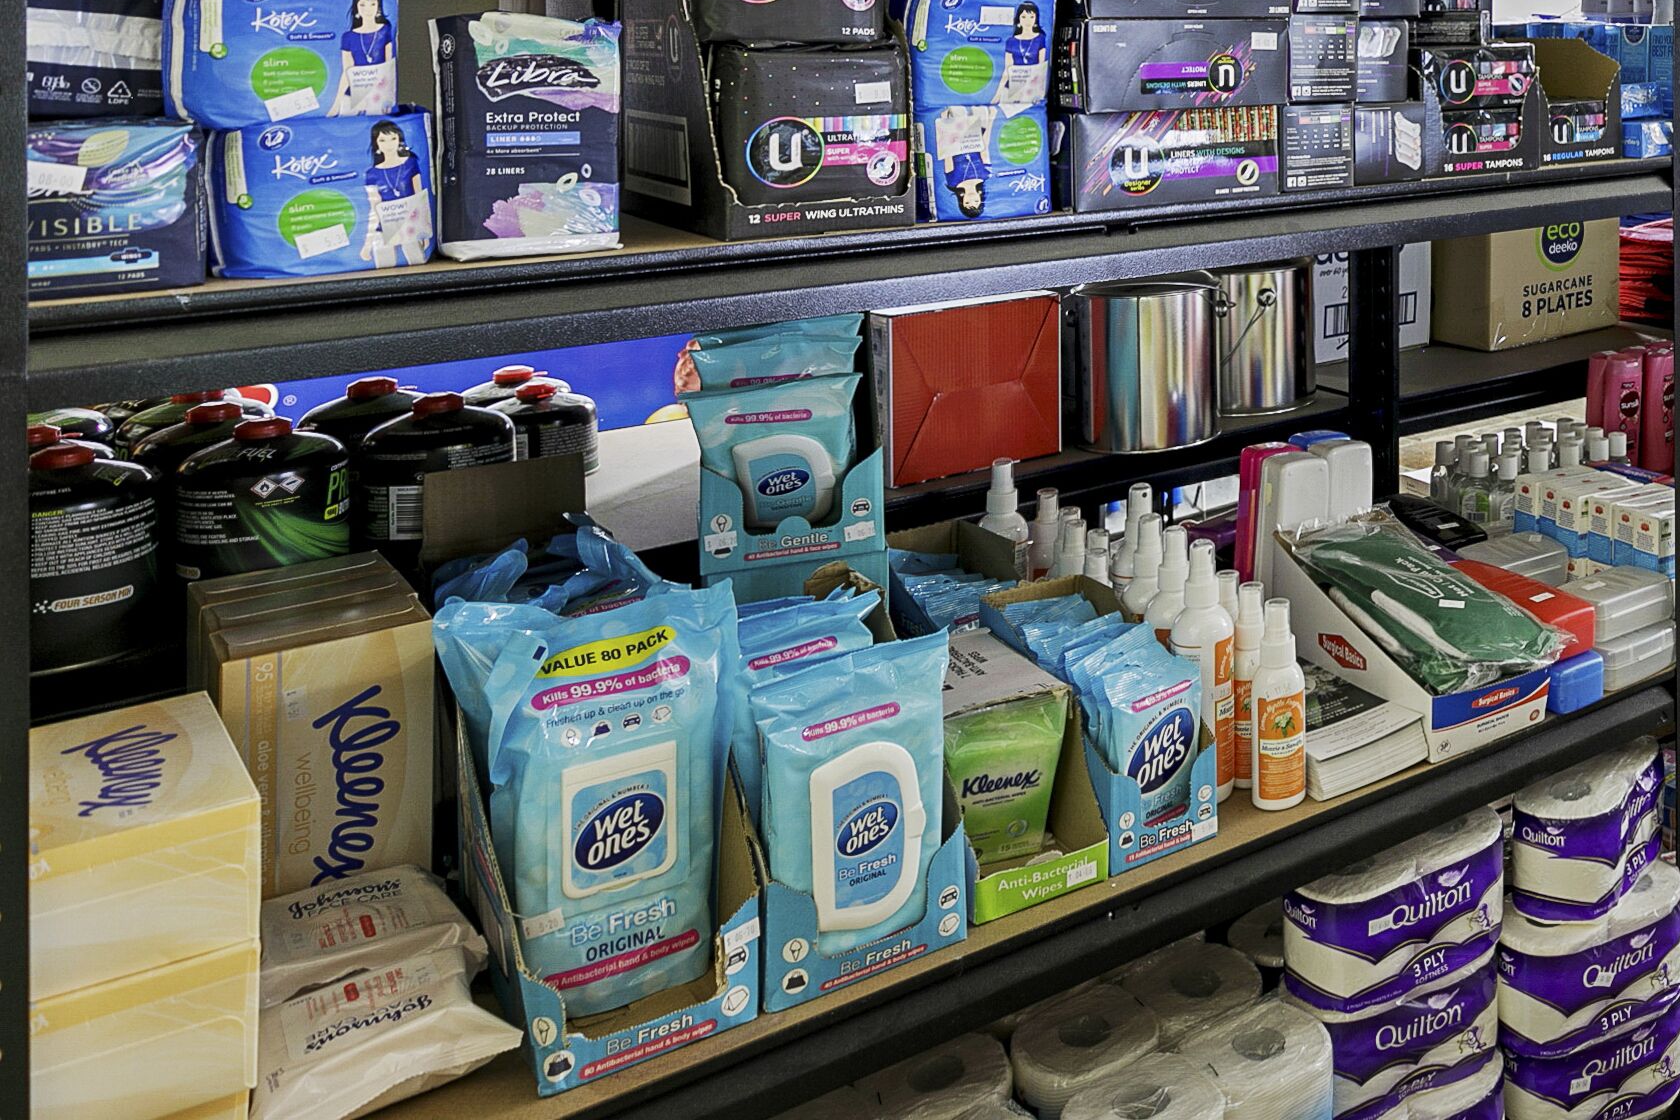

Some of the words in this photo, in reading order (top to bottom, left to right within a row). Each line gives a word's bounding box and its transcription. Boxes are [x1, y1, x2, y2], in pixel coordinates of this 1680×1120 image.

[251, 6, 317, 36] Kotex
[842, 28, 850, 36] 12
[852, 27, 875, 36] PADS
[945, 14, 990, 36] Kotex
[262, 57, 290, 68] slim
[486, 60, 599, 88] Libra
[486, 112, 523, 124] Extra
[528, 111, 581, 122] Protect
[827, 147, 850, 156] SUPER
[1170, 149, 1196, 160] LINERS
[1196, 148, 1215, 158] WITH
[1215, 146, 1246, 156] DESIGNS
[1444, 163, 1453, 173] 16
[1455, 161, 1484, 172] SUPER
[1485, 158, 1523, 170] TAMPONS
[1543, 153, 1552, 162] 16
[1552, 150, 1584, 161] REGULAR
[1584, 147, 1615, 159] TAMPONS
[272, 155, 339, 181] Kotex
[485, 168, 496, 176] 28
[497, 166, 525, 175] LINERS
[288, 202, 315, 213] slim
[748, 213, 761, 225] 12
[764, 211, 801, 224] SUPER
[805, 208, 836, 220] WING
[838, 204, 905, 218] ULTRATHINS
[1546, 221, 1580, 242] eco
[1548, 241, 1579, 255] deeko
[1522, 274, 1593, 298] SUGARCANE
[1522, 301, 1532, 318] 8
[1536, 289, 1593, 317] PLATES
[765, 479, 803, 496] ones
[768, 472, 799, 488] wet
[31, 509, 64, 518] DANGER
[54, 598, 80, 611] FOUR
[80, 593, 114, 608] SEASON
[114, 588, 133, 601] MIX
[540, 651, 598, 676] VALUE
[601, 648, 622, 662] 80
[626, 630, 669, 657] PACK
[1321, 634, 1345, 660] Surgical
[1344, 648, 1365, 669] Basics
[542, 690, 569, 706] Kills
[570, 678, 623, 699] 99.9%
[624, 674, 637, 687] of
[638, 663, 681, 685] bacteria
[1477, 691, 1499, 707] Surgical
[1498, 688, 1516, 701] Basics
[824, 714, 858, 734] 99.9%
[858, 711, 868, 724] of
[867, 704, 896, 722] bacteria
[1143, 713, 1182, 760] wet
[1136, 737, 1186, 787] ones
[961, 768, 1040, 799] Kleenex
[286, 751, 312, 855] wellbeing
[593, 799, 645, 841] wet
[850, 805, 886, 837] wet
[1139, 834, 1157, 849] Be
[1157, 820, 1194, 845] Fresh
[587, 818, 652, 866] ones
[845, 819, 890, 856] ones
[1522, 824, 1567, 848] Quilton
[838, 865, 857, 882] Be
[858, 852, 898, 877] Fresh
[849, 868, 888, 888] ORIGINAL
[997, 855, 1089, 892] Anti-Bacterial
[288, 880, 401, 920] Johnson's
[1021, 881, 1064, 901] Wipes
[1284, 897, 1318, 931] Quilton
[1390, 881, 1473, 932] Quilton
[570, 924, 603, 947] Be
[608, 898, 677, 930] Fresh
[585, 926, 667, 963] ORIGINAL
[839, 957, 862, 976] Be
[865, 939, 914, 966] Fresh
[560, 962, 617, 987] Antibacterial
[617, 954, 641, 971] hand
[641, 952, 650, 962] &
[650, 945, 671, 961] body
[671, 935, 696, 951] wipes
[1413, 956, 1424, 977] 3
[1423, 948, 1448, 973] PLY
[1582, 936, 1658, 989] Quilton
[1375, 1002, 1467, 1053] Quilton
[1600, 1016, 1611, 1032] 3
[1610, 1004, 1634, 1028] PLY
[606, 1037, 633, 1057] Be
[637, 1014, 694, 1045] Fresh
[1580, 1032, 1658, 1085] Quilton
